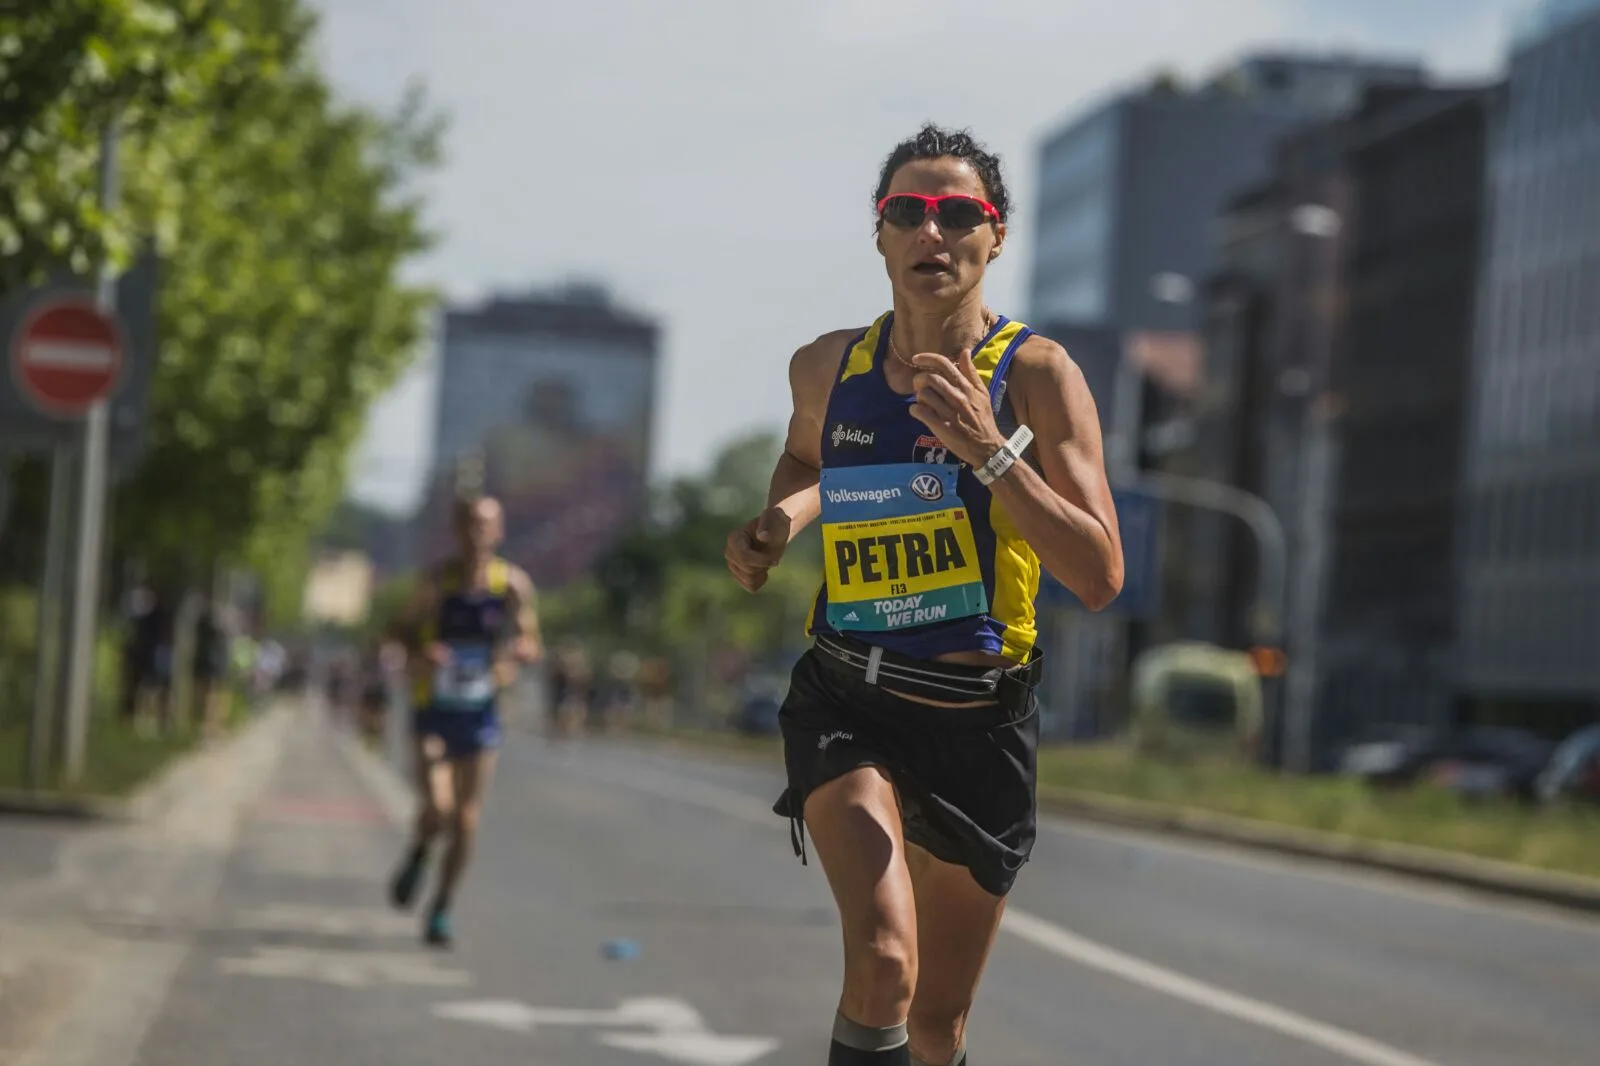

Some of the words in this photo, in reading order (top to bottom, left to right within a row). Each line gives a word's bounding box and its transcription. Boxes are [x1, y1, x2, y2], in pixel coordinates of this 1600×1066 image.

[846, 429, 874, 445] kilpi
[826, 487, 901, 503] Volkswagen
[834, 527, 967, 586] PETRA
[874, 595, 924, 614] TODAY
[887, 611, 912, 627] WE
[914, 604, 947, 622] RUN
